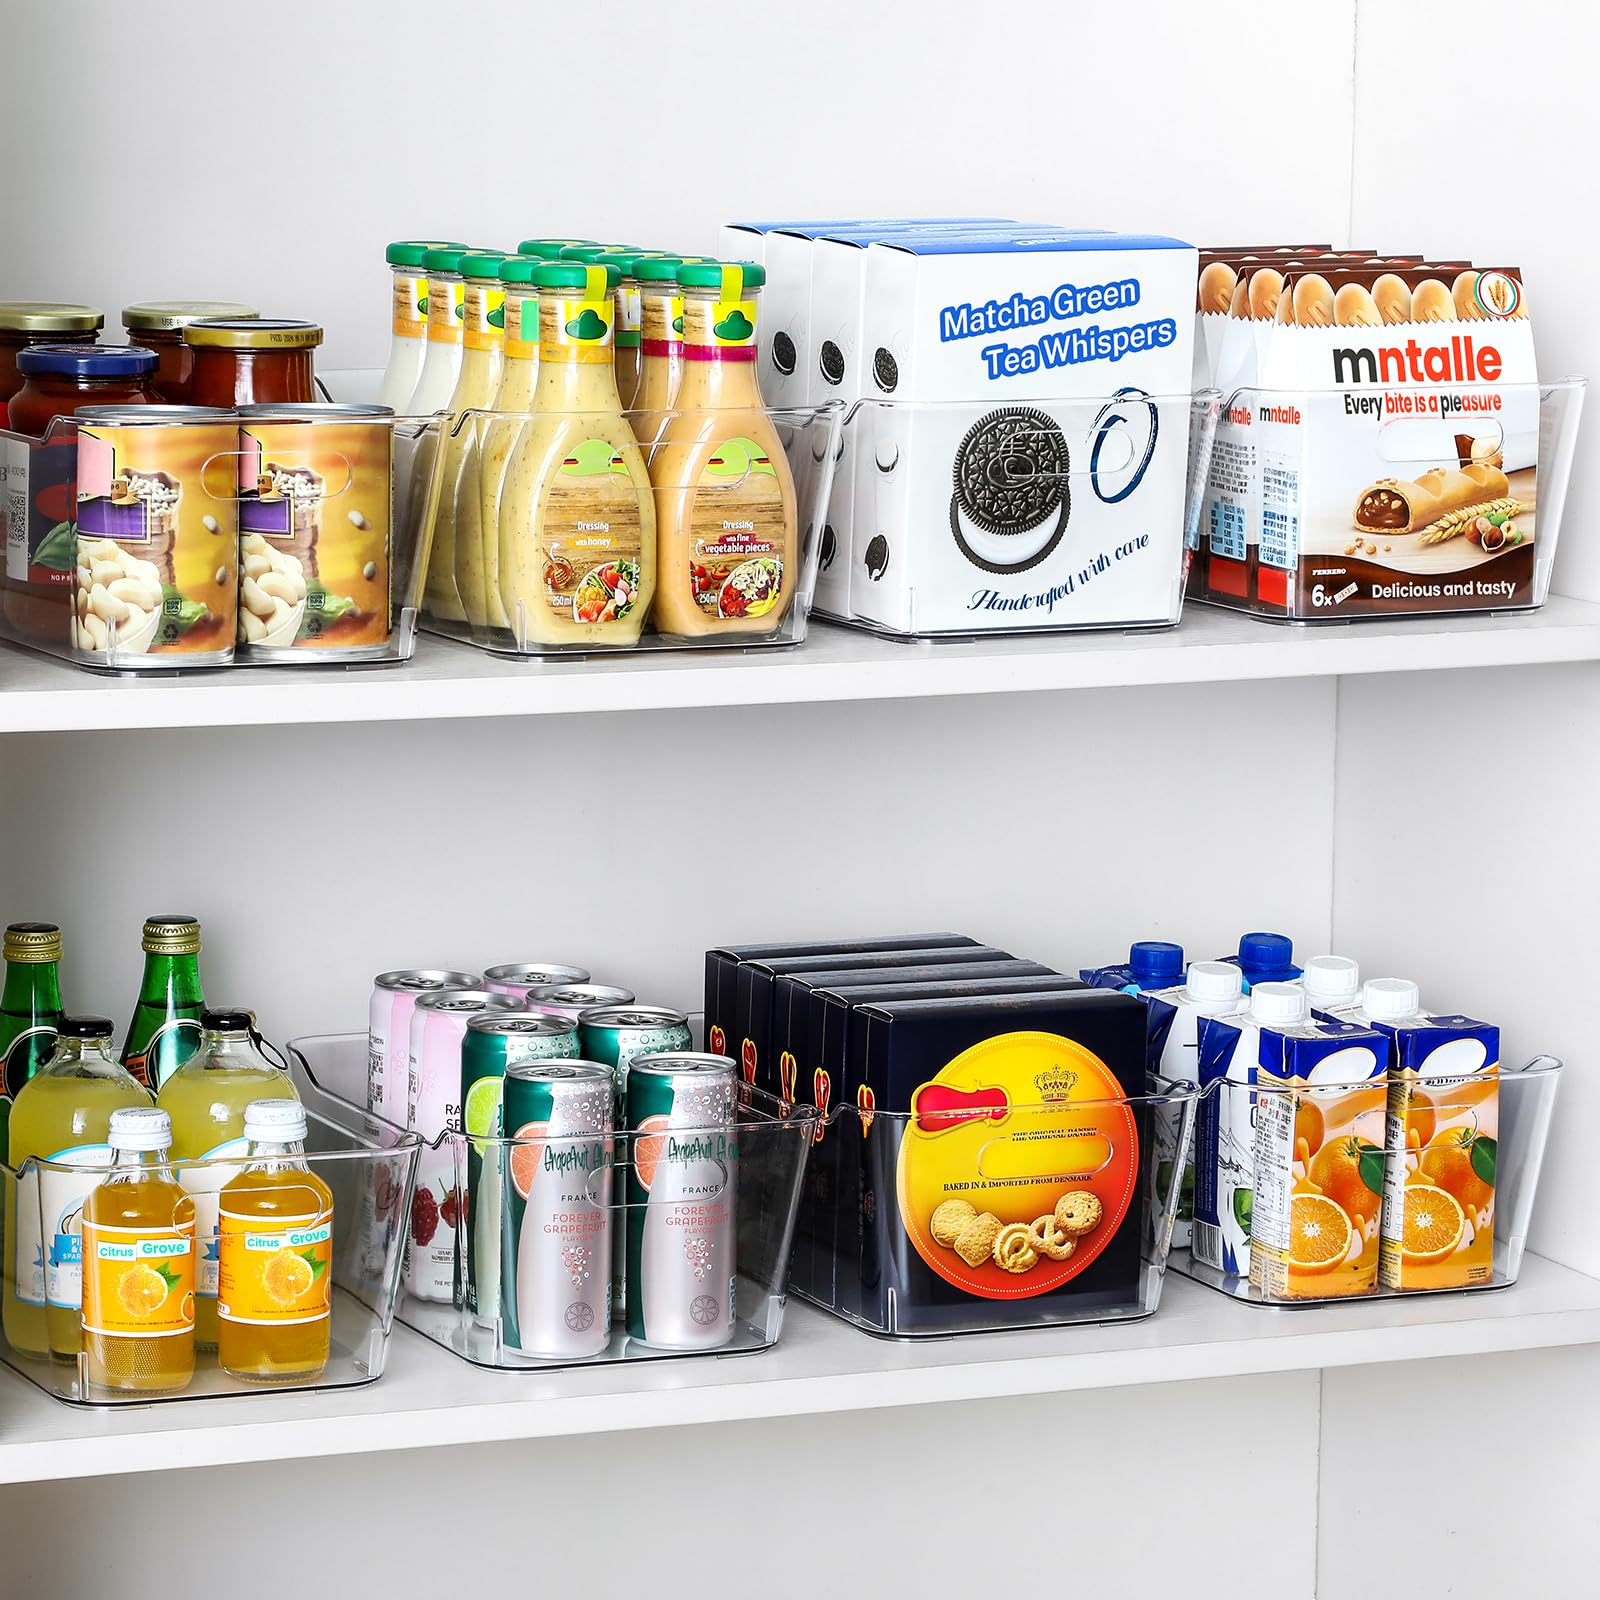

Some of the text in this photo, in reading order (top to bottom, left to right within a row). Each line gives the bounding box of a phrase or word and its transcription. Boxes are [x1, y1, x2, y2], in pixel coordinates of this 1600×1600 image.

[943, 282, 1136, 338] Matcha Green
[161, 317, 173, 327] USE
[985, 321, 1173, 377] Tea Whispers
[1332, 335, 1503, 384] mntalle
[1344, 392, 1502, 421] Every bite is a pleasure
[1259, 405, 1301, 425] mntalle
[577, 520, 610, 532] Dressing
[722, 520, 754, 531] Dressing
[587, 536, 611, 548] honey
[737, 533, 750, 542] fine
[704, 542, 770, 556] vegetable pieces
[966, 533, 1150, 615] Handcrafted with care
[1312, 568, 1347, 576] FERRERO
[1311, 584, 1333, 608] 6x
[1371, 579, 1517, 599] Delicious and tasty
[682, 1184, 720, 1194] FRANCE
[943, 1174, 1093, 1192] BAKED IN & IMPORTED FROM DENMARK
[561, 1191, 597, 1202] FRANCE
[674, 1204, 724, 1216] FOREVER
[552, 1212, 601, 1223] FOREVER
[665, 1213, 729, 1227] GRAPEFRUIT
[543, 1220, 607, 1234] GRAPEFRUIT
[247, 1229, 328, 1248] Citrus Grove
[99, 1242, 185, 1257] Citrus Grove
